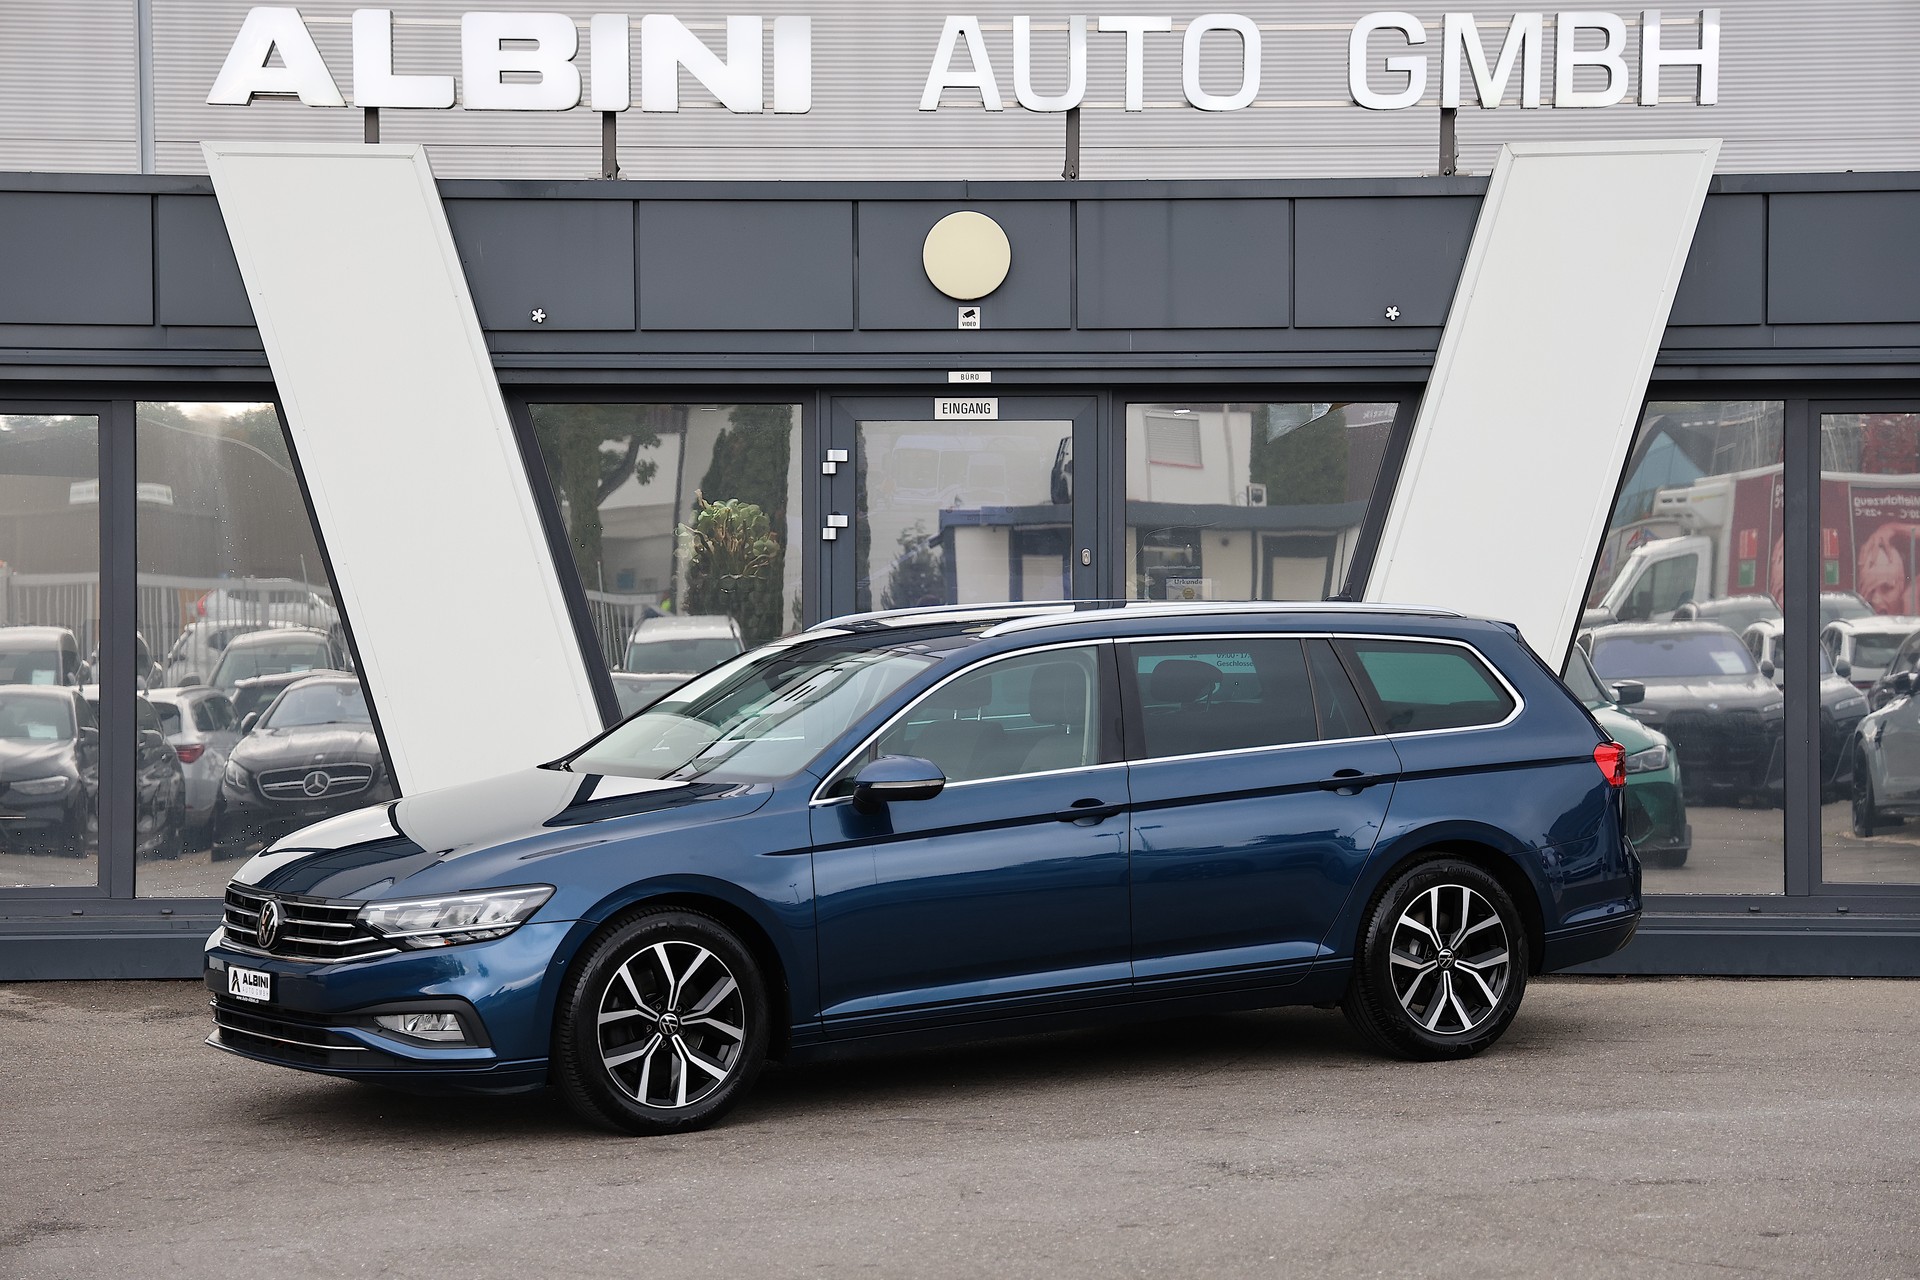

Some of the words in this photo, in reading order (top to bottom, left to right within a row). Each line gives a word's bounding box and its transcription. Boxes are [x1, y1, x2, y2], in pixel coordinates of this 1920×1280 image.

[208, 7, 812, 115] ALBINI
[919, 11, 1262, 112] AUTO
[1347, 7, 1722, 111] GMBH
[960, 373, 980, 381] BÜRO
[942, 402, 991, 414] EINGANG
[242, 972, 269, 989] ALBINI
